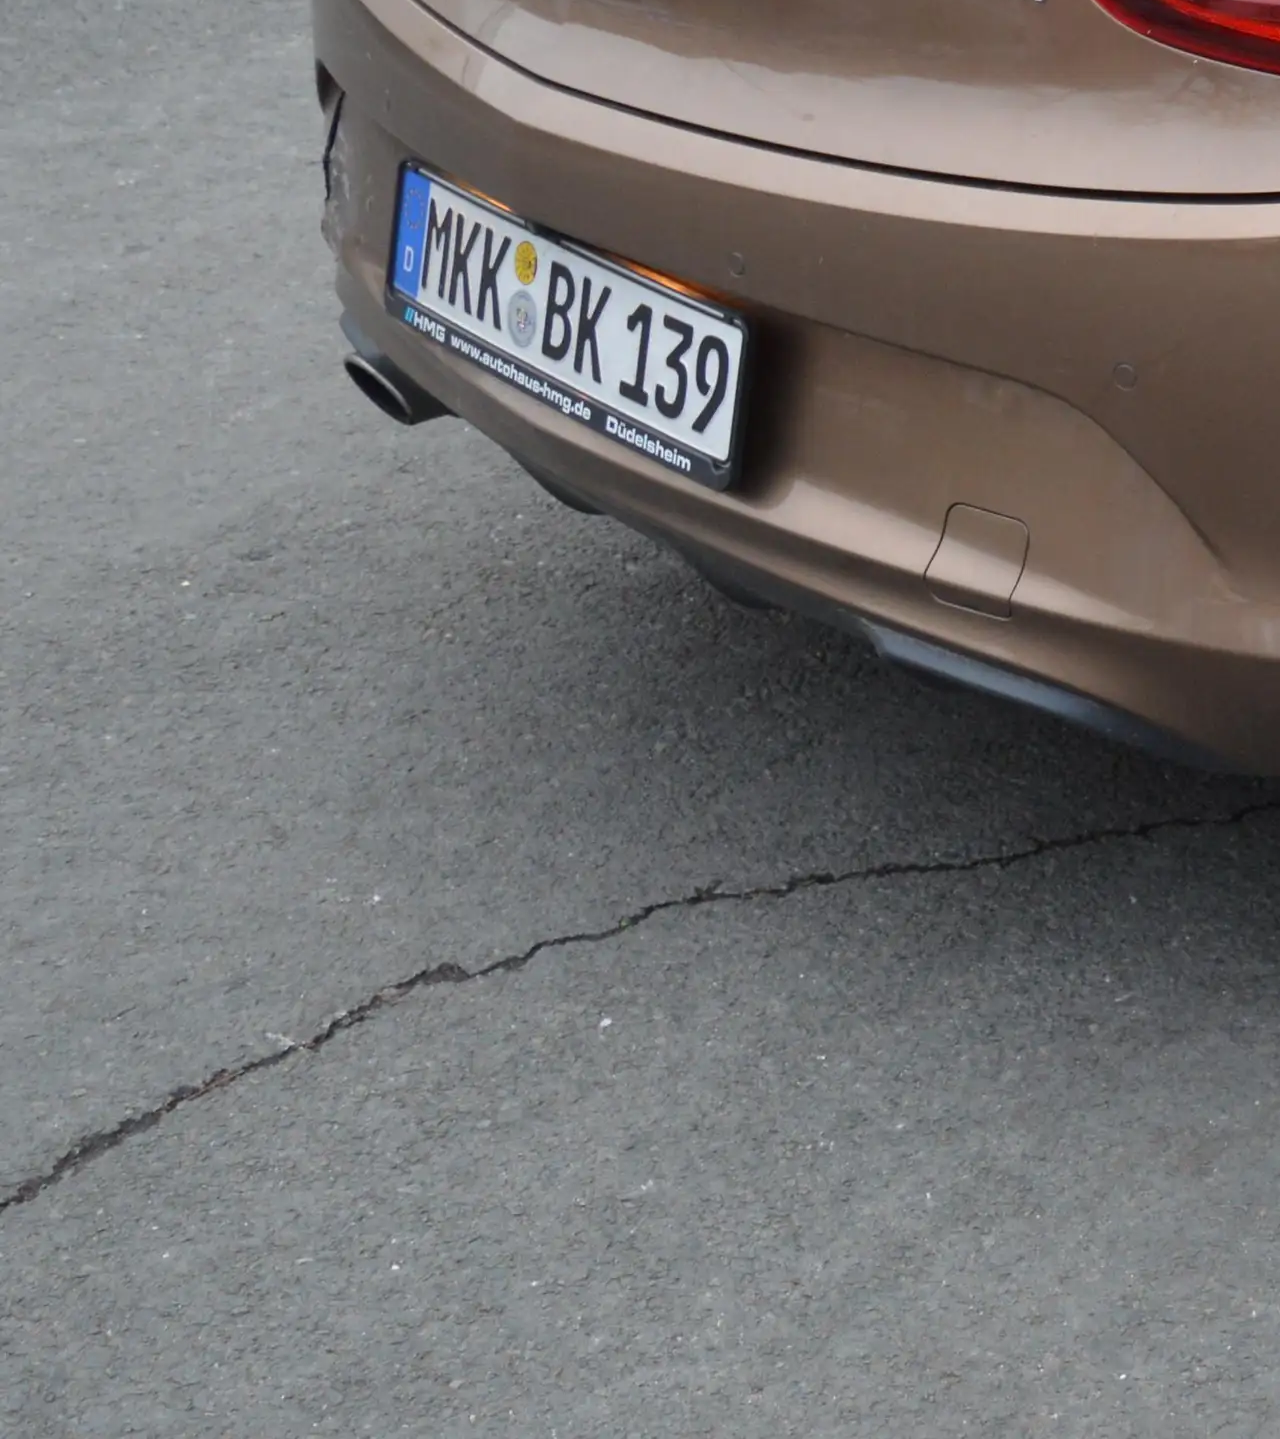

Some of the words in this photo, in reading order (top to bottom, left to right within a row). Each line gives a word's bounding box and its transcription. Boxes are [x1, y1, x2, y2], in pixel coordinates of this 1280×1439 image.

[403, 245, 413, 272] D
[421, 198, 512, 331] MKK
[541, 261, 612, 385] BK
[618, 303, 730, 434] 139
[450, 334, 592, 421] www.autohaus-hmg.de
[605, 415, 692, 472] Düdelsheim
